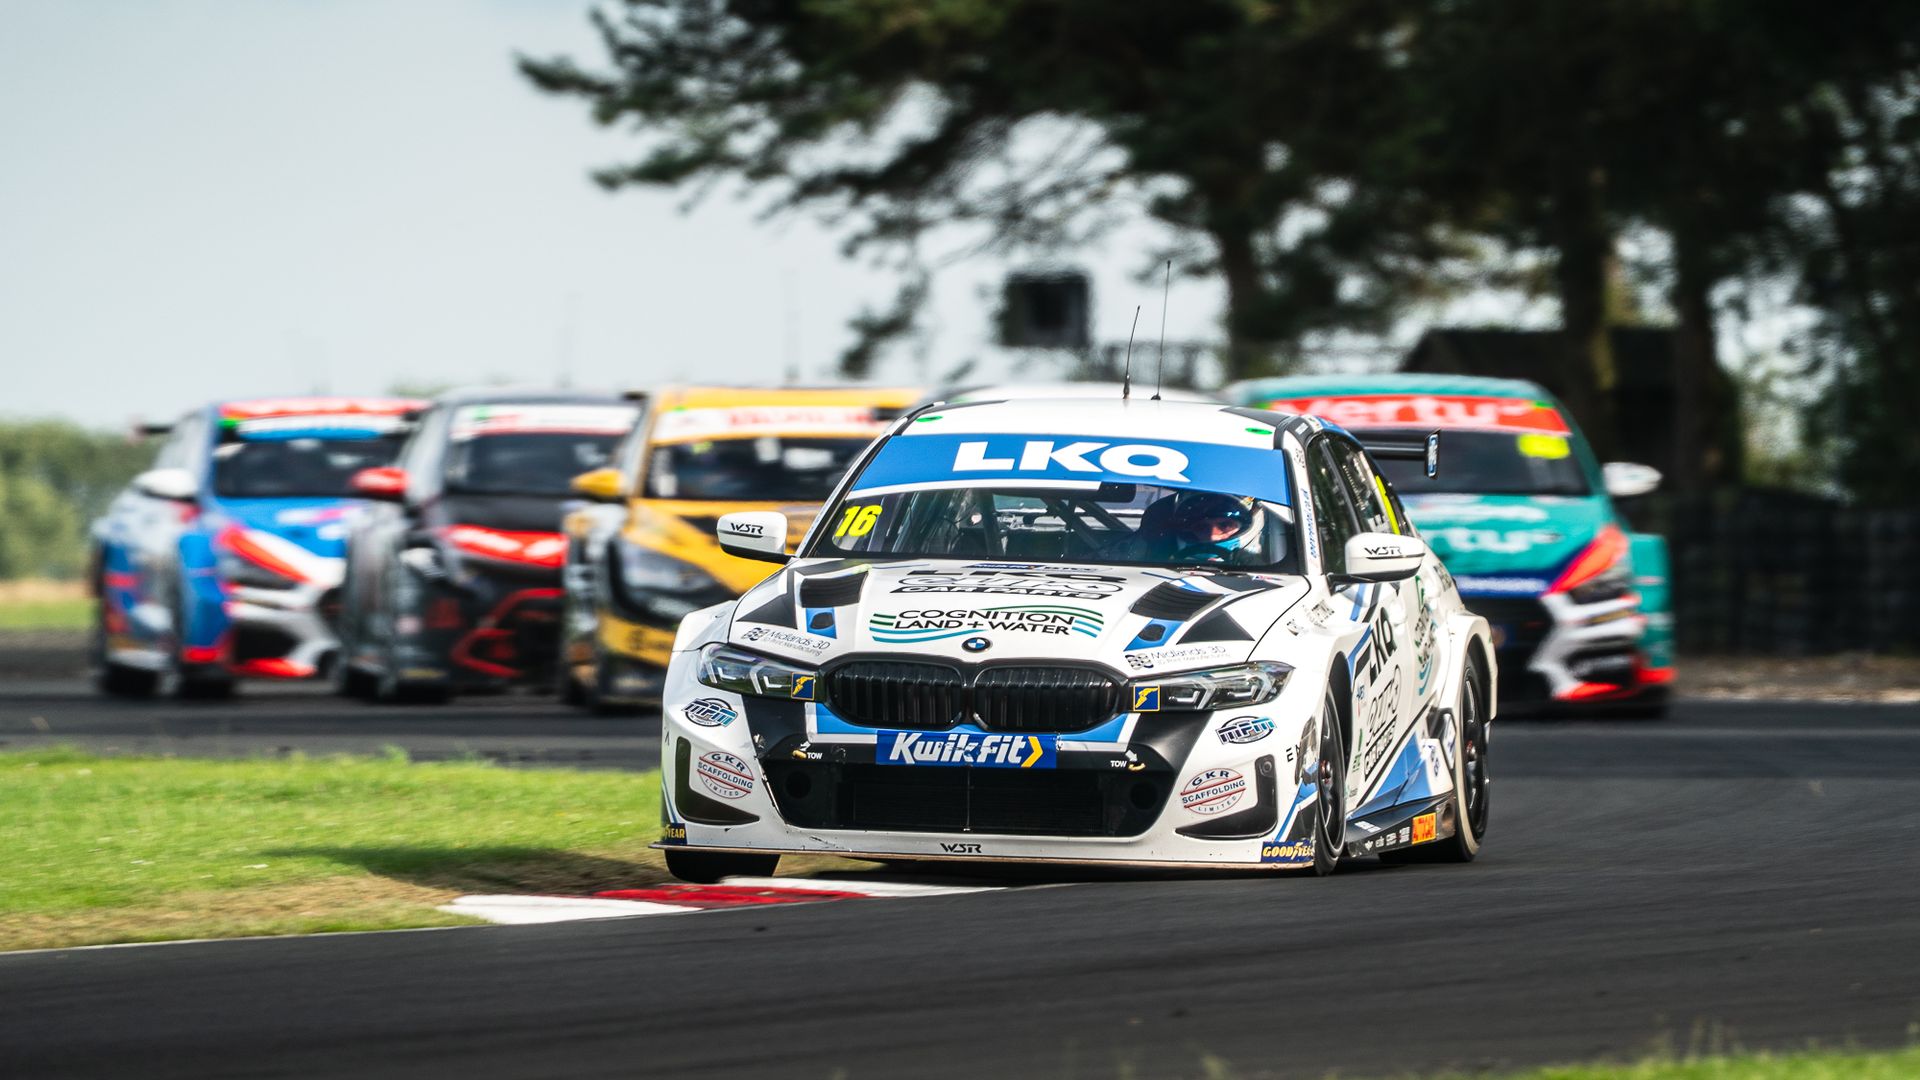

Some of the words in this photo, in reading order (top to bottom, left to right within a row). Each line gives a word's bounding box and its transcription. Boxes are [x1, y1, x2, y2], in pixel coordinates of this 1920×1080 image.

[952, 440, 1192, 483] LKQ
[730, 522, 764, 535] WSR
[834, 504, 883, 537] 16
[1363, 546, 1402, 555] WSR
[899, 609, 1075, 625] COGNITION
[894, 619, 957, 630] LAND
[989, 622, 1071, 636] WATER
[711, 753, 745, 773] GKR
[807, 752, 823, 760] TOW
[1110, 760, 1127, 768] TOW
[697, 761, 753, 790] SCAFFOLDING
[1192, 770, 1230, 787] GKR
[705, 777, 739, 797] LIMITED
[1182, 779, 1245, 804] SCAFFOLDING
[1198, 795, 1237, 812] LIMITED
[940, 842, 982, 854] WSR
